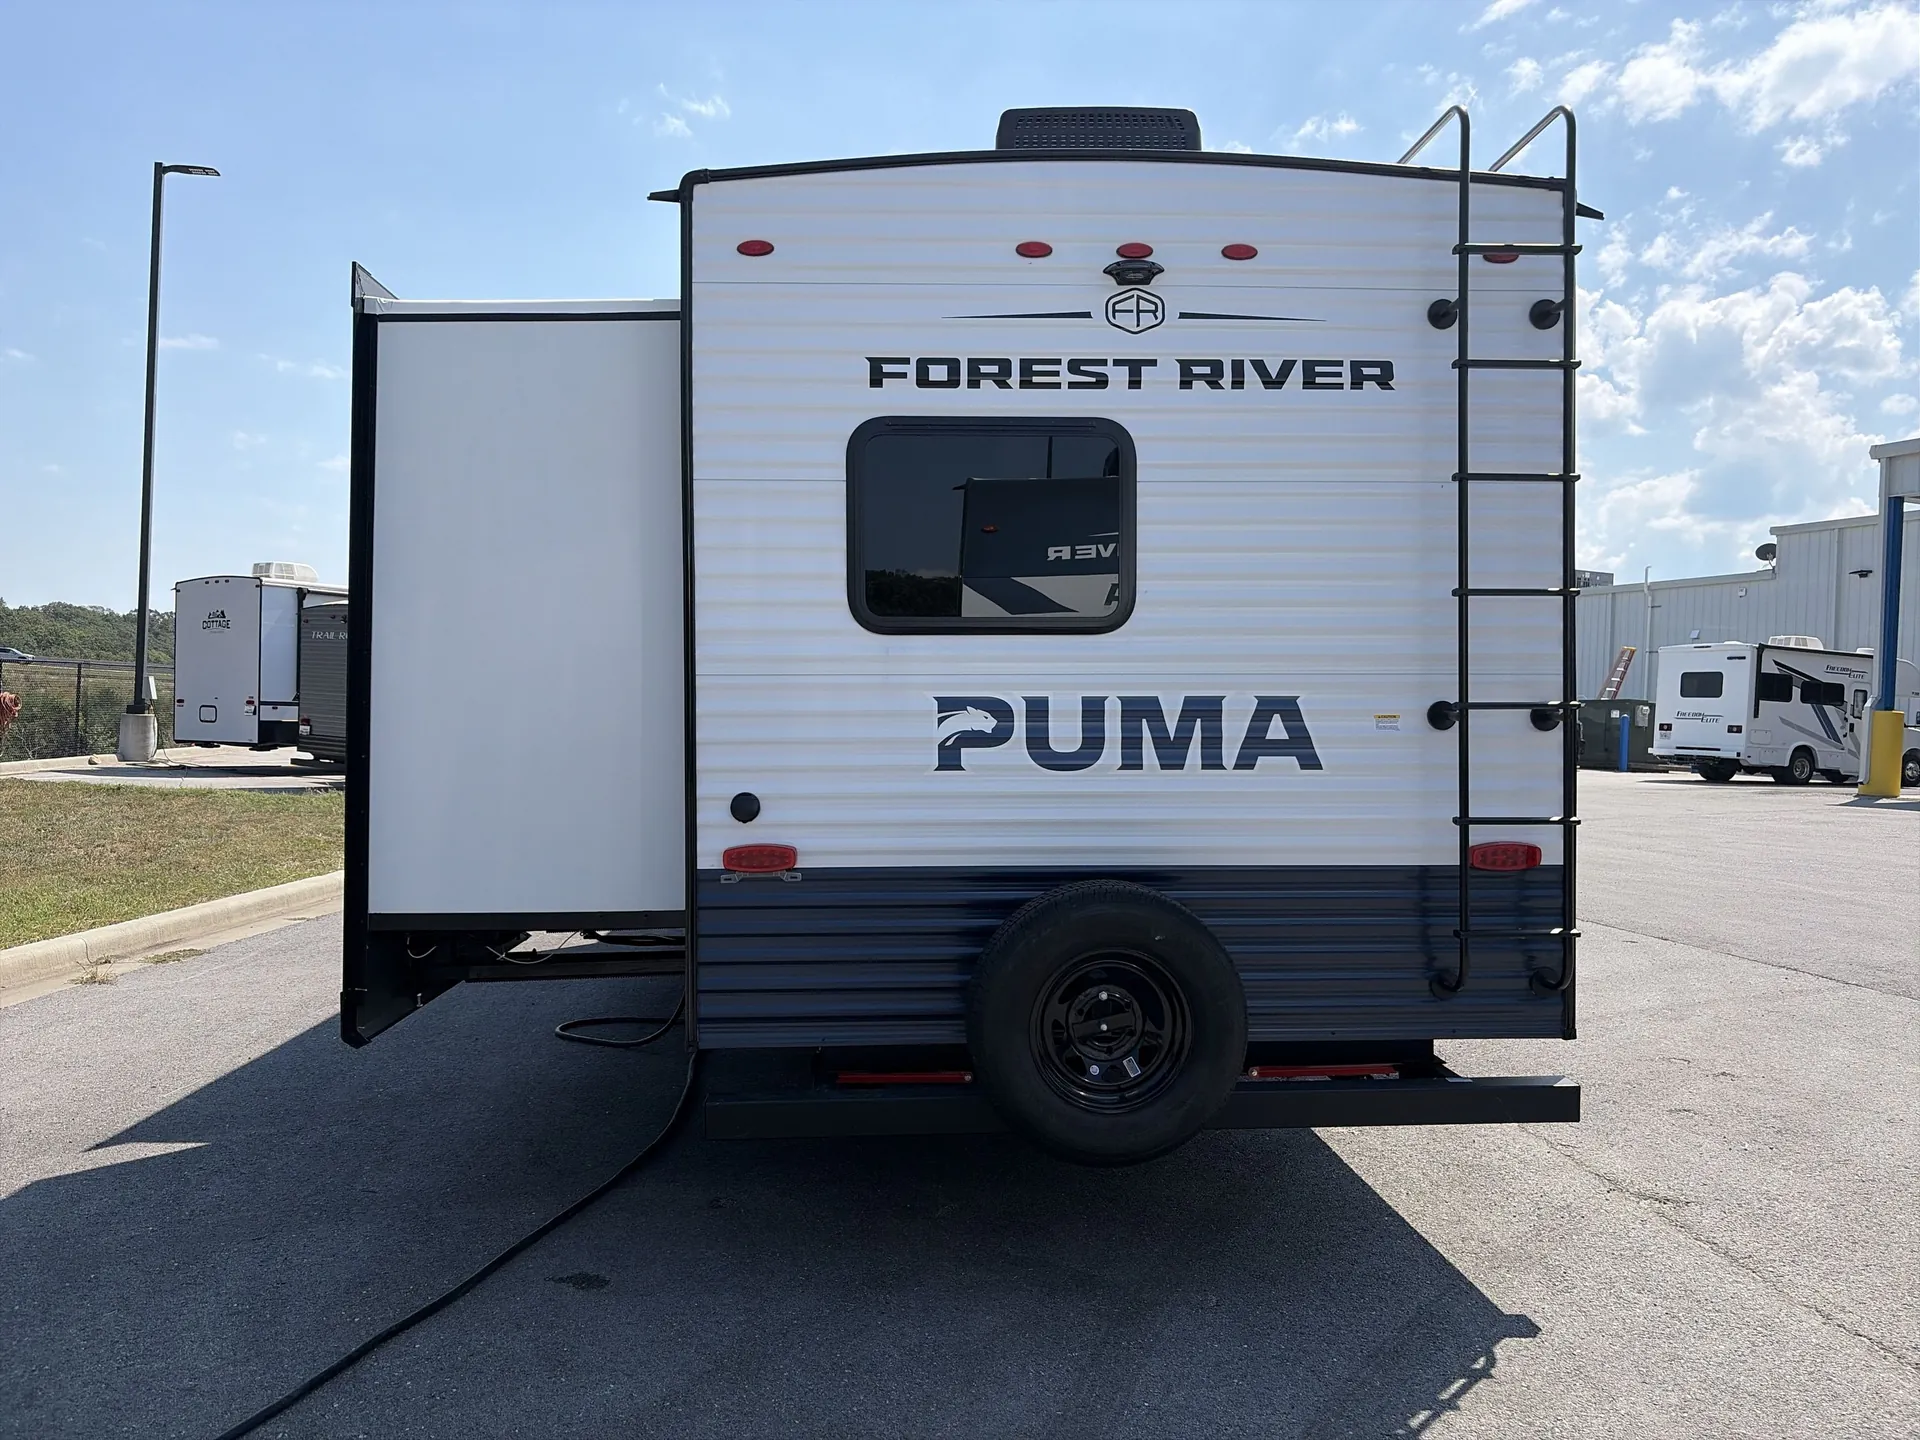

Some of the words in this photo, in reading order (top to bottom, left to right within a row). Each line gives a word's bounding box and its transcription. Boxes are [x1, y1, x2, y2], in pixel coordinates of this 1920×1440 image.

[865, 356, 1158, 390] FOREST
[1174, 358, 1396, 391] RIVER
[201, 619, 231, 630] COTTAGE
[311, 630, 336, 640] TRAIL
[932, 695, 1324, 772] PUMA
